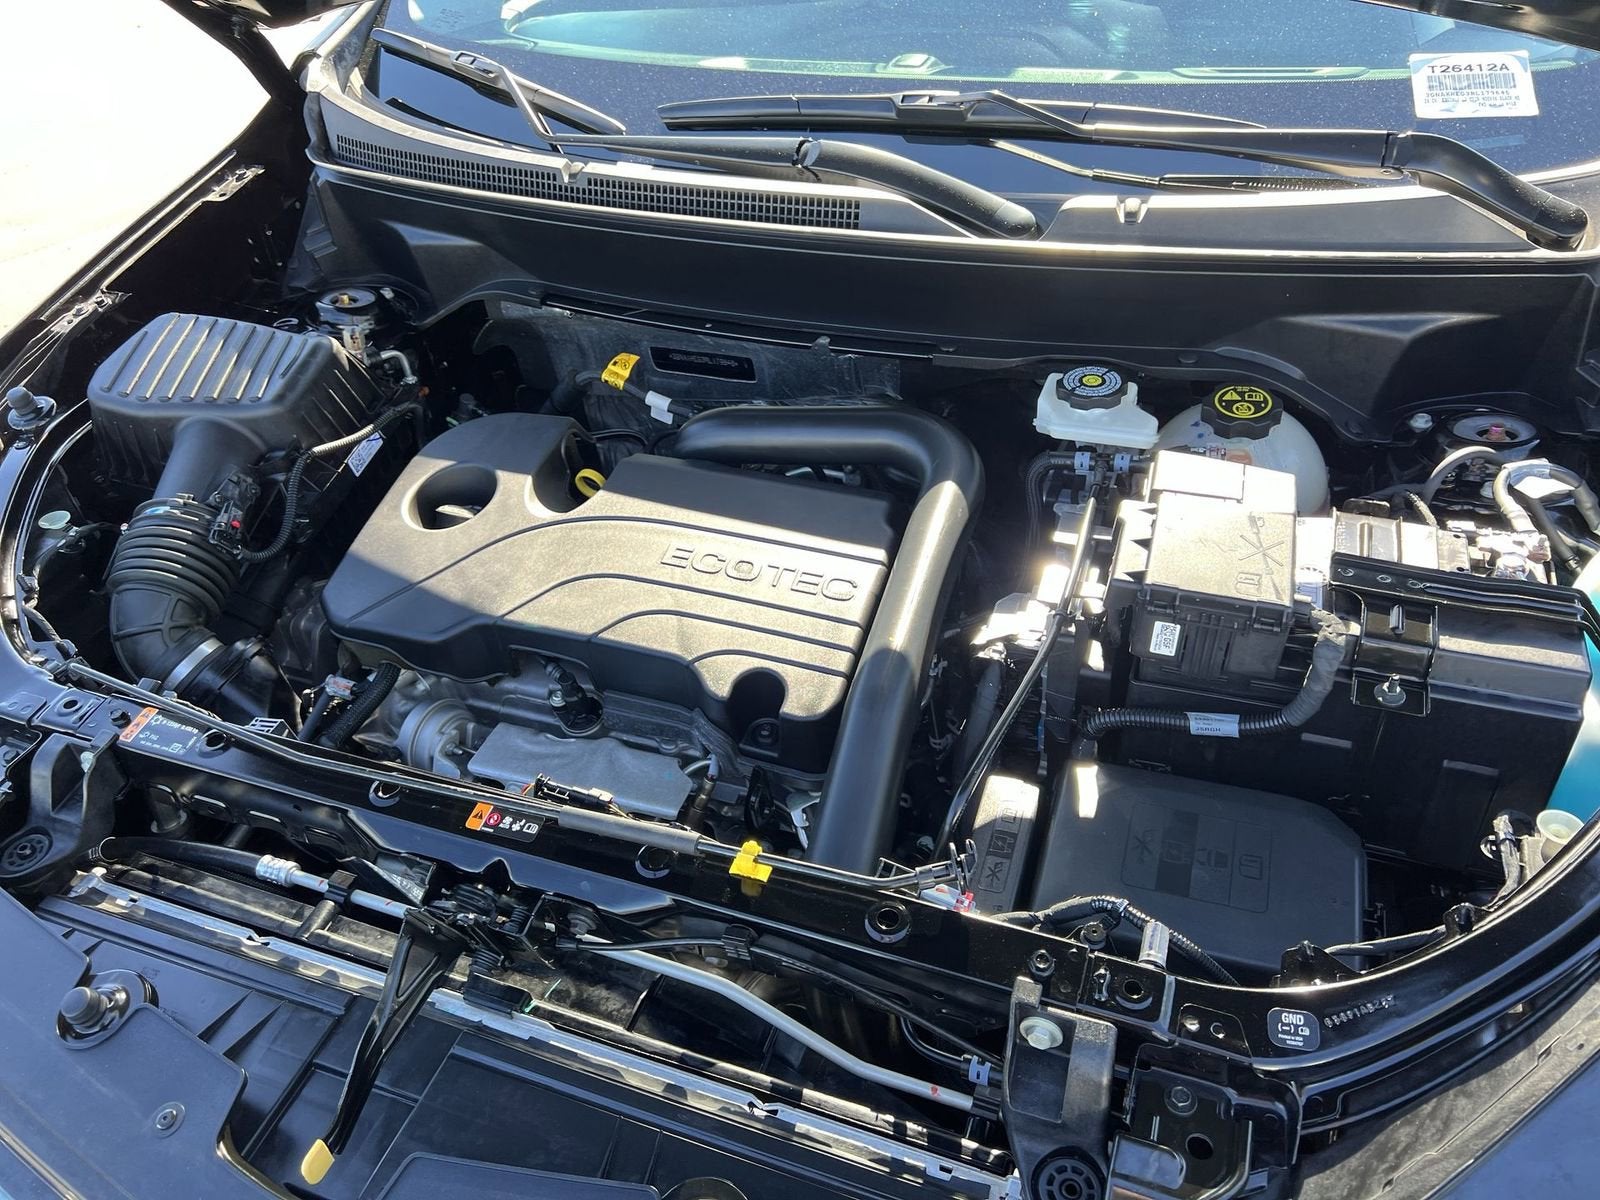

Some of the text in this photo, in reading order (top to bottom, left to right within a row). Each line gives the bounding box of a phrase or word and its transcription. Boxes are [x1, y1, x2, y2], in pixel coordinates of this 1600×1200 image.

[1428, 63, 1510, 74] T26412A
[660, 543, 858, 602] ECOTEC
[1281, 1012, 1304, 1025] GND
